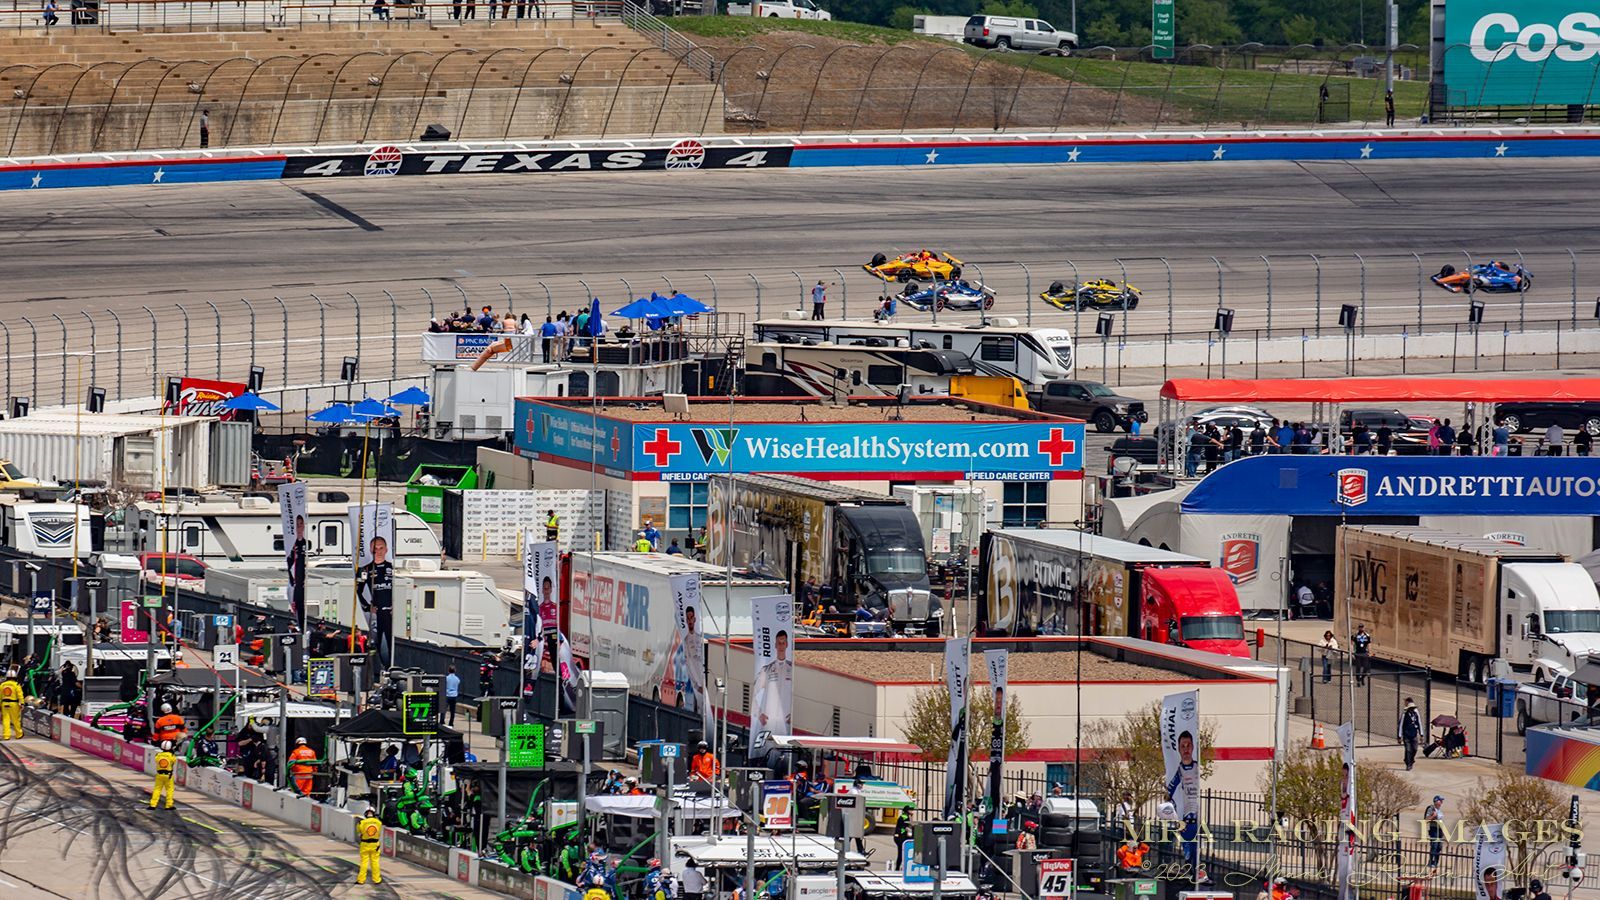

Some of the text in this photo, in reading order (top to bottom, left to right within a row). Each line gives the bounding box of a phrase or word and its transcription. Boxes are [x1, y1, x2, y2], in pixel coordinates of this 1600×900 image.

[303, 151, 768, 176] 4 TEXAS 4
[744, 436, 1030, 465] WiseHealthSystem.com
[661, 473, 691, 481] INFIELD
[996, 472, 1018, 480] CARE
[1019, 472, 1050, 480] CENTER
[285, 491, 295, 536] PEDERSEN
[1221, 532, 1261, 541] ANDRETTI
[1033, 560, 1072, 591] BITNILE
[1351, 550, 1388, 605] PMG
[677, 591, 686, 629] VEEKAY
[763, 627, 771, 658] ROBB
[315, 670, 328, 685] 51
[954, 665, 963, 698] ILOTT
[410, 703, 431, 718] 77
[766, 796, 789, 816] 30
[1042, 875, 1068, 892] 45
